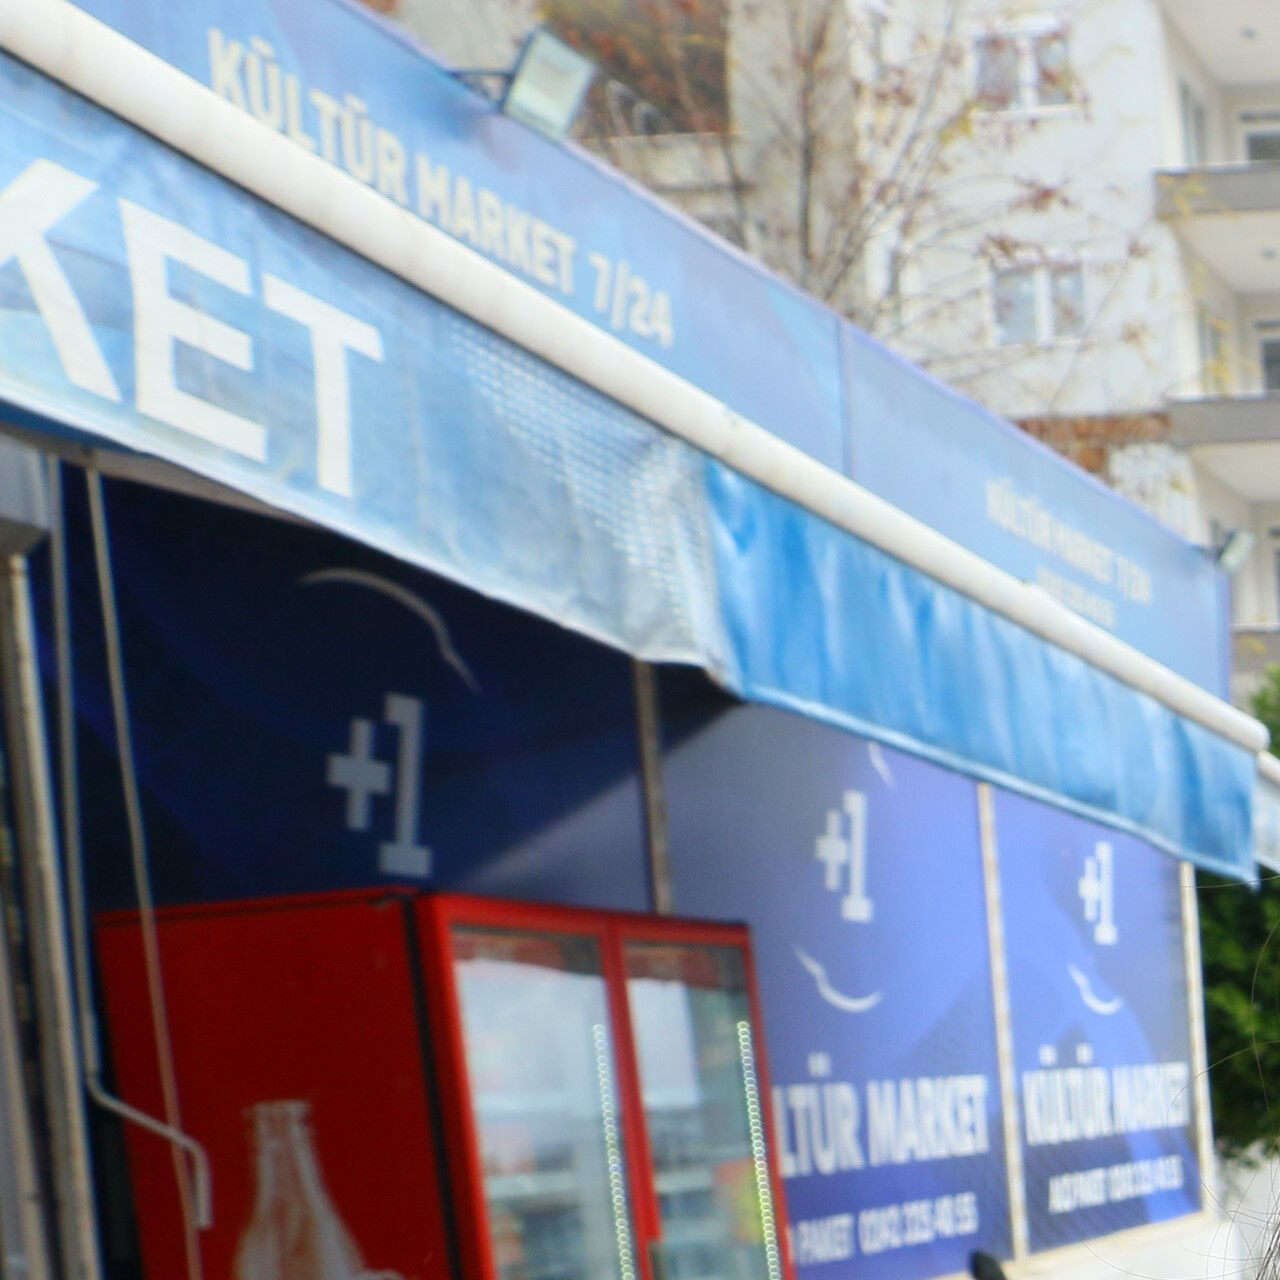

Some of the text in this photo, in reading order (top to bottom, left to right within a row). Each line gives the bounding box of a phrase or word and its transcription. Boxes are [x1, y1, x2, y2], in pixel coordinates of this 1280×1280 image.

[208, 27, 676, 350] KÜLTÜR MARKET 7/24
[772, 1052, 990, 1178] LTÜR MARKET
[1023, 1042, 1113, 1147] KÜLTÜR
